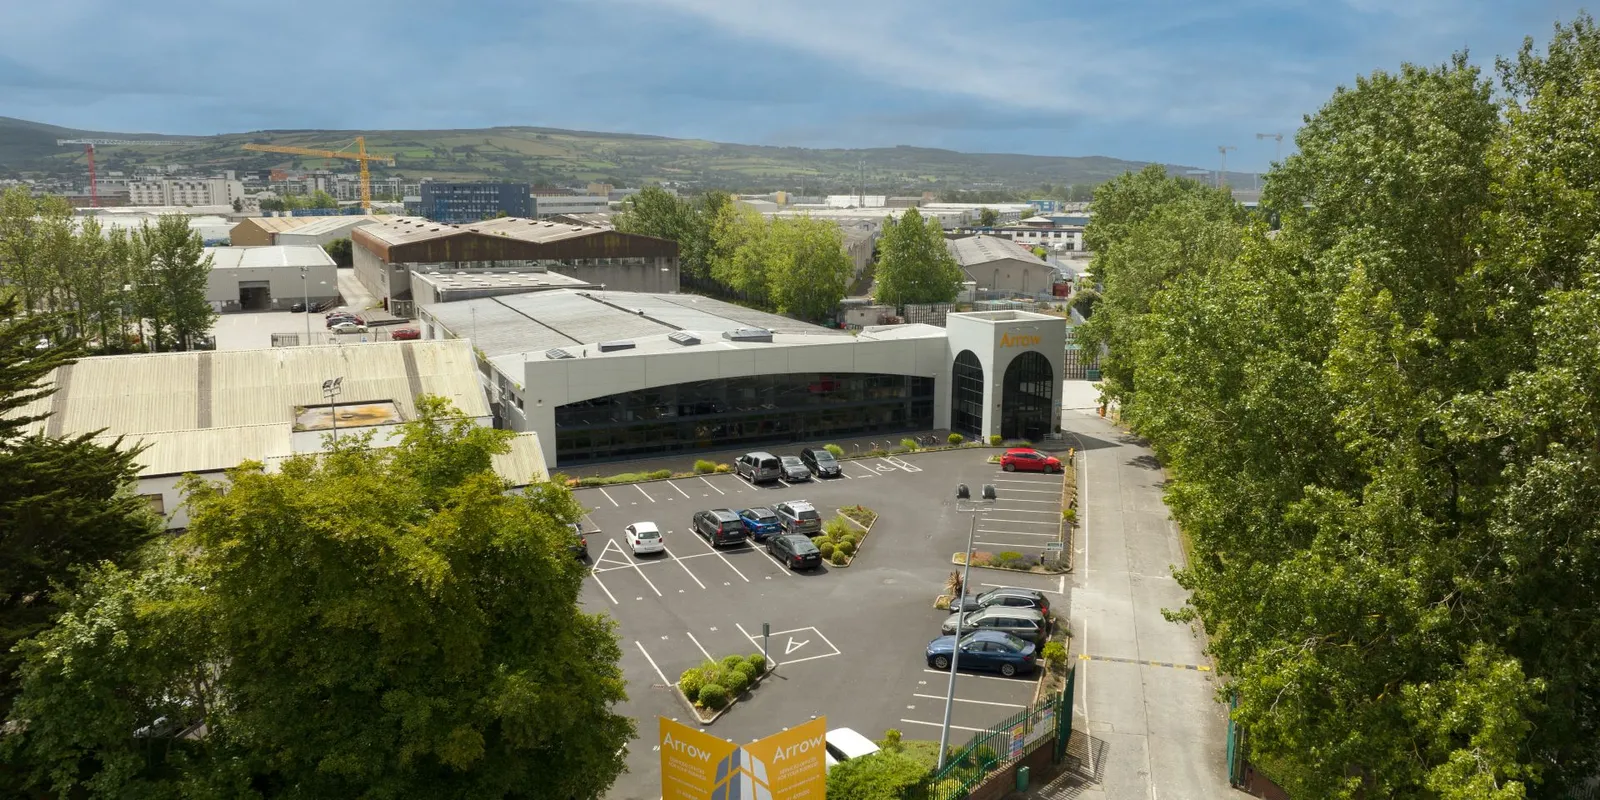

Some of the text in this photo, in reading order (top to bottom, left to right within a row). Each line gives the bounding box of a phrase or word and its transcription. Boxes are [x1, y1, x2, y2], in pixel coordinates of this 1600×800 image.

[1000, 332, 1041, 348] Arrow
[663, 732, 712, 763] Arrow
[772, 734, 824, 764] Arrow
